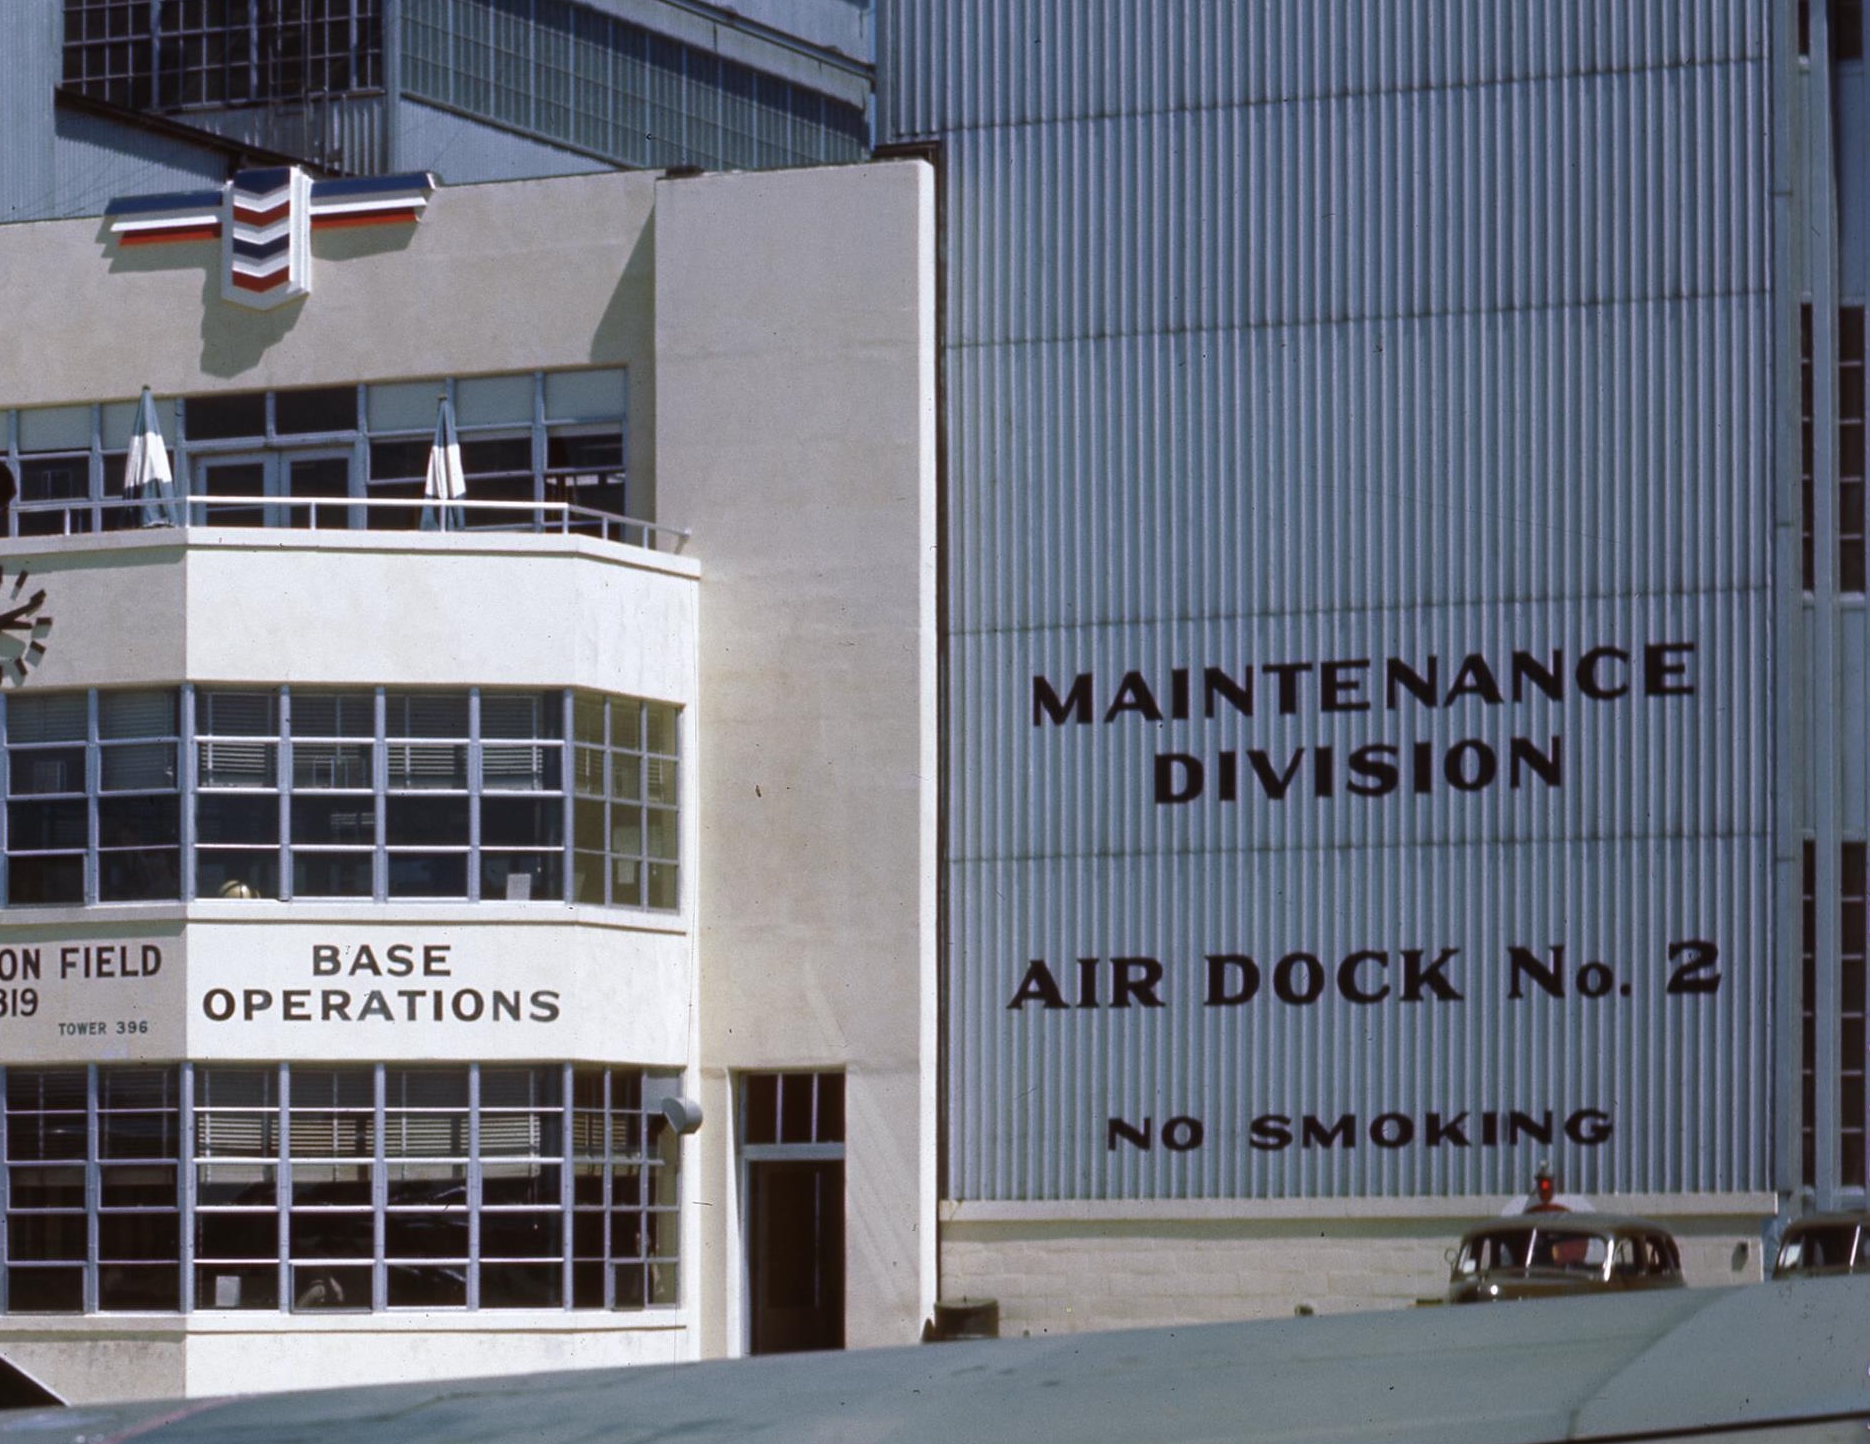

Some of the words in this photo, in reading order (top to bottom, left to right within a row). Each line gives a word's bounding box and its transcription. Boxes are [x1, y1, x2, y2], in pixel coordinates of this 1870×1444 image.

[1032, 641, 1696, 727] MAINTENANCE
[1153, 734, 1561, 805] DIVISION
[59, 944, 162, 979] FIELD
[311, 944, 452, 977] BASE
[1007, 957, 1167, 1009] AIR
[1203, 947, 1464, 1007] DOCK
[1507, 944, 1632, 1000] No.
[1666, 939, 1722, 994] 2
[202, 987, 561, 1023] OPERATIONS
[58, 1021, 107, 1036] TOWER
[116, 1020, 149, 1035] 396
[1106, 1115, 1205, 1152] NO
[1248, 1108, 1614, 1151] SMOKING
